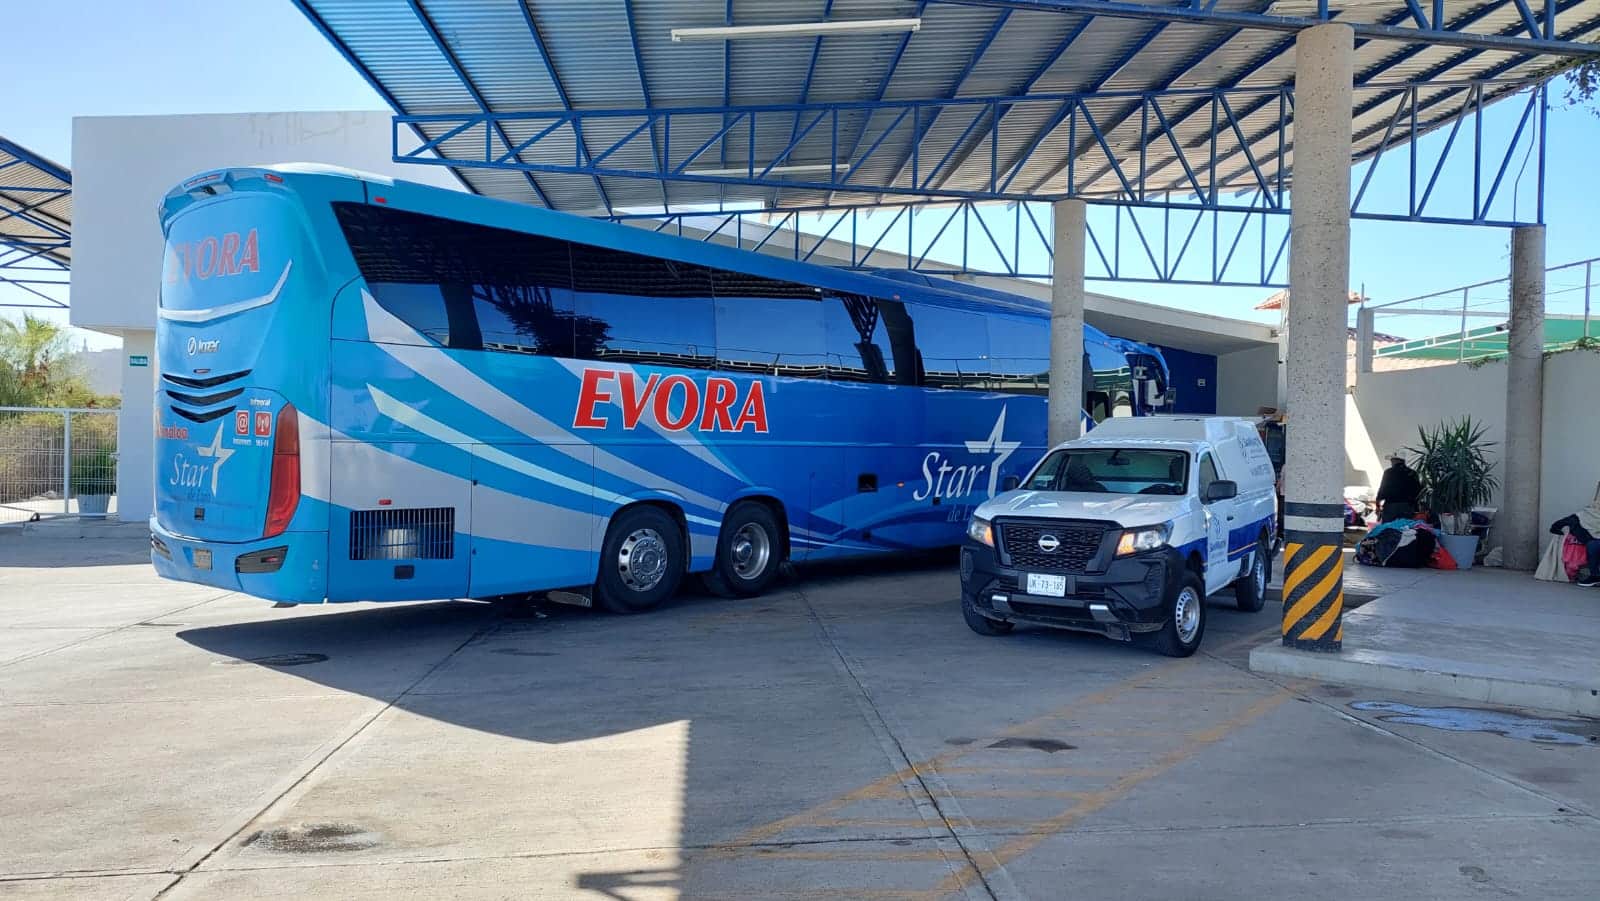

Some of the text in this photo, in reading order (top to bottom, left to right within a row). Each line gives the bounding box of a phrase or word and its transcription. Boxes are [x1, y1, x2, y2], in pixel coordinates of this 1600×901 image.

[572, 368, 769, 433] EVORA
[170, 453, 208, 487] Star
[913, 451, 985, 500] Star
